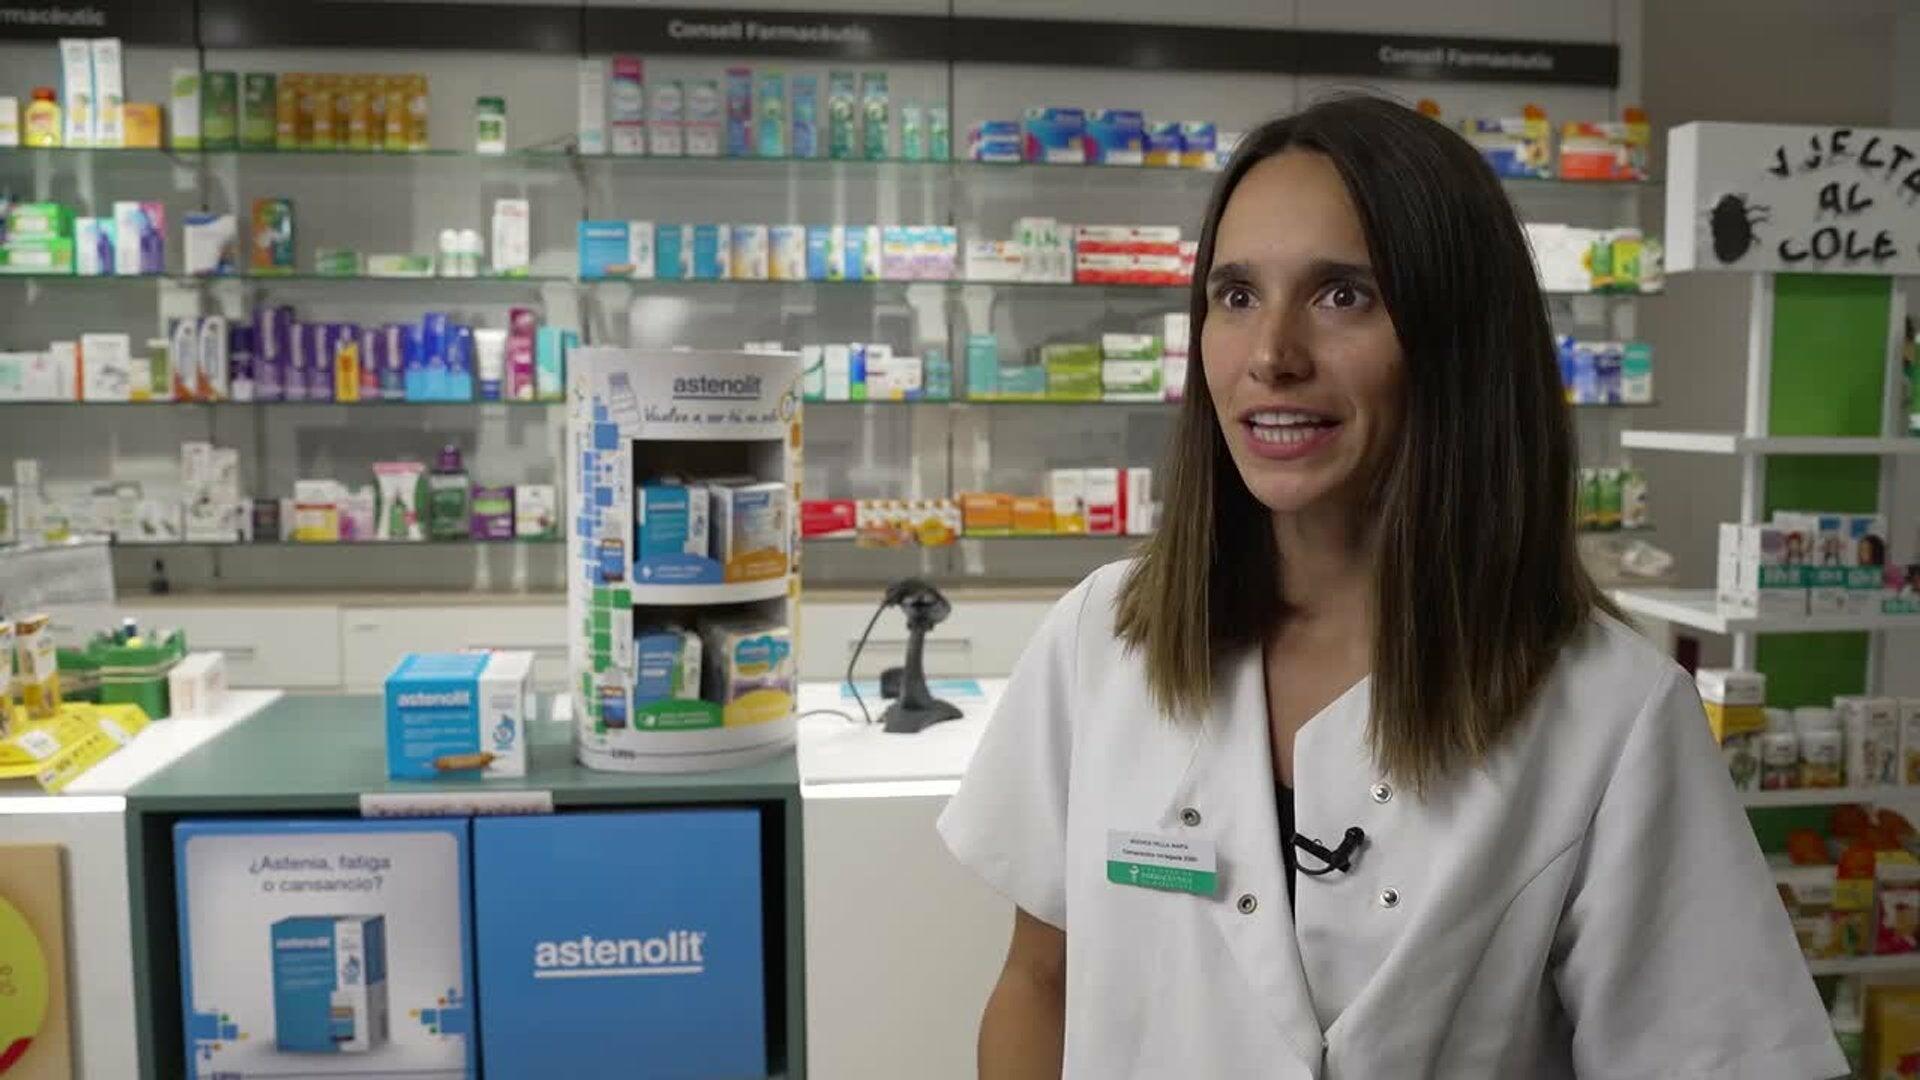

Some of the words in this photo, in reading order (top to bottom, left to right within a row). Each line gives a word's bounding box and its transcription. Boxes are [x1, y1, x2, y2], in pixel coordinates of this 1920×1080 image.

[1778, 226, 1897, 262] COLE
[672, 375, 762, 394] astenolit
[263, 880, 275, 892] o
[534, 930, 705, 967] astenolit
